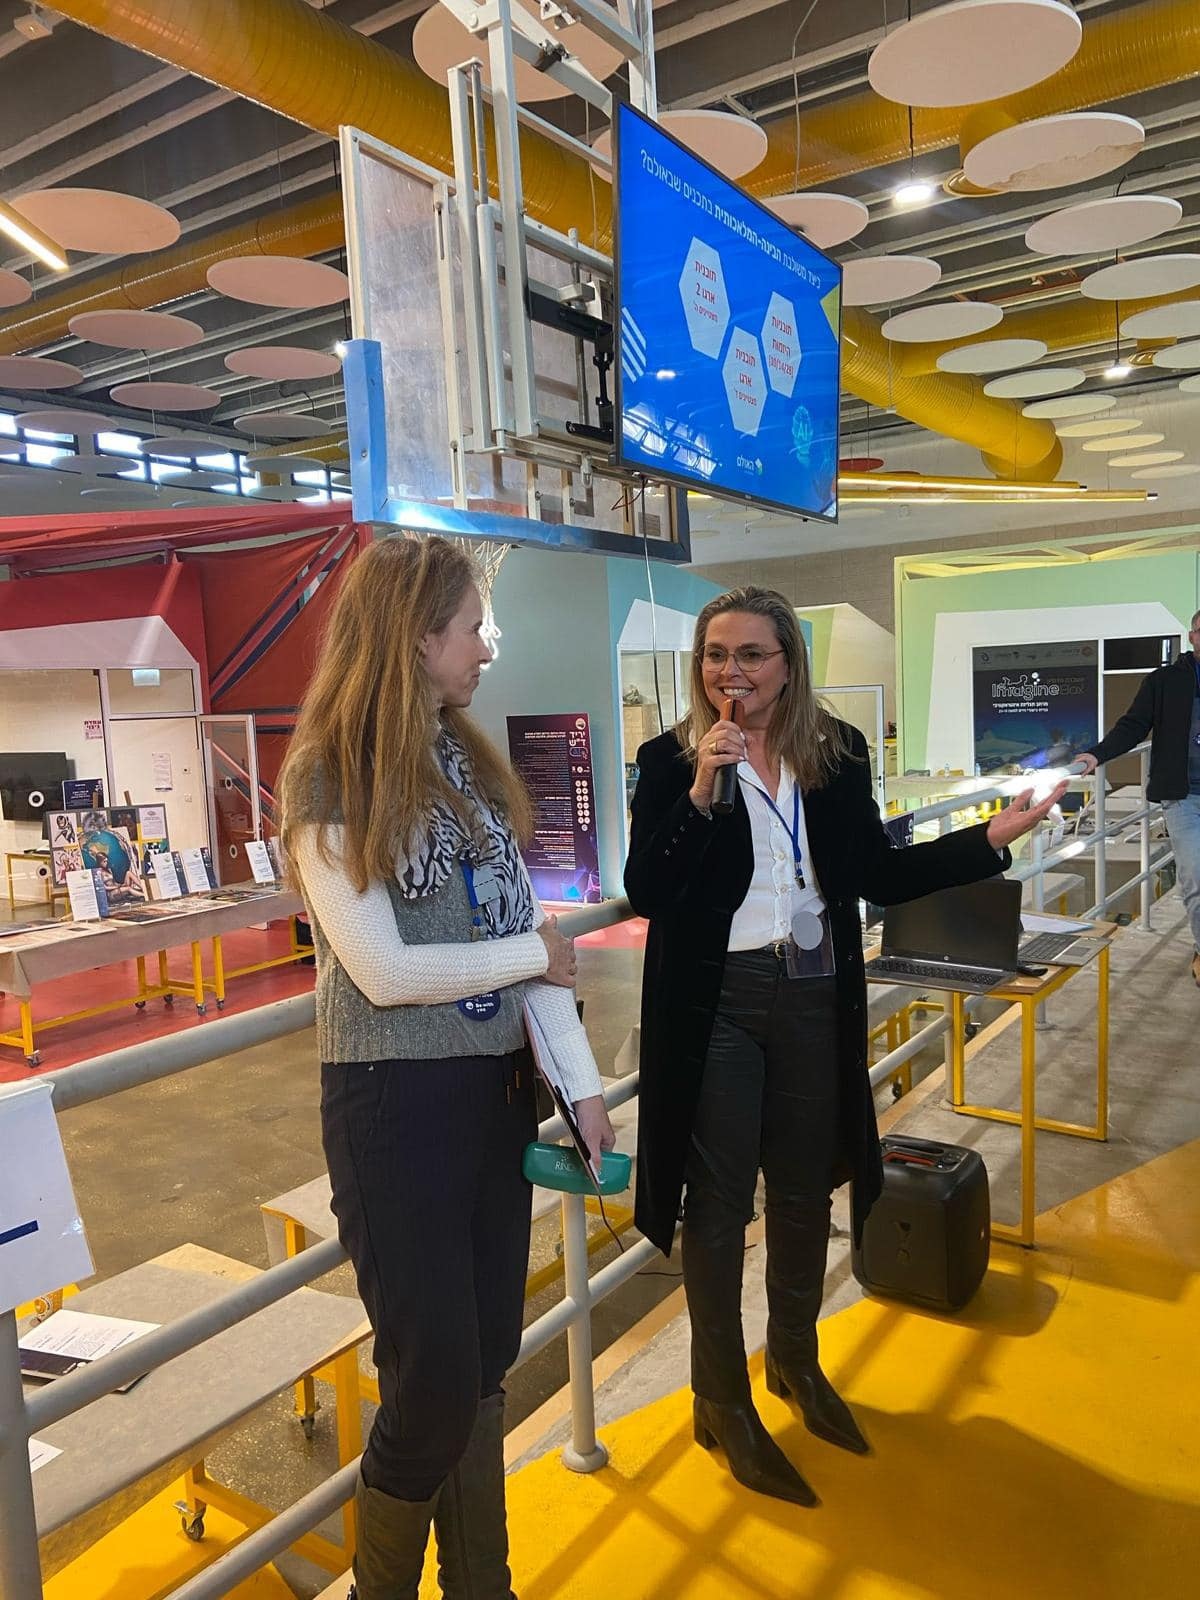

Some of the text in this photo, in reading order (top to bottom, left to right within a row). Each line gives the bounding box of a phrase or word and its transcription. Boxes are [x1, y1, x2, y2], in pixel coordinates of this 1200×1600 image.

[640, 148, 681, 193] שבאולם?
[683, 182, 713, 216] בתכנים
[783, 253, 807, 280] משולבת
[695, 282, 701, 296] 2
[808, 270, 821, 289] כיצד
[797, 421, 808, 441] AI
